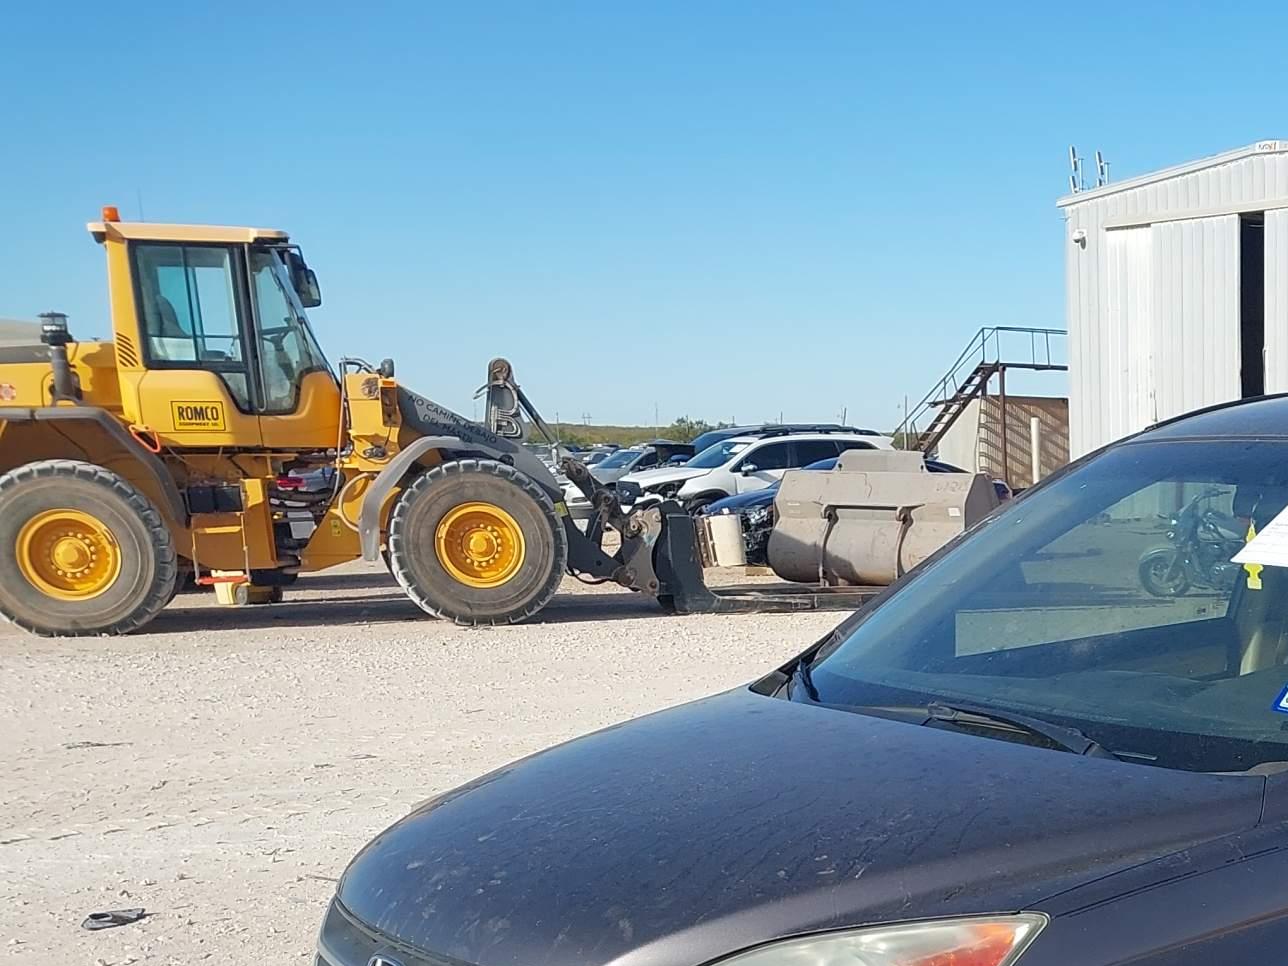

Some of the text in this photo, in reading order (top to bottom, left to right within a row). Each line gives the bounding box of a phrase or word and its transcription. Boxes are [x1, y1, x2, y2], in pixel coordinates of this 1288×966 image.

[177, 405, 219, 421] ROMCO
[408, 394, 425, 407] NO
[426, 403, 462, 426] CAMINE
